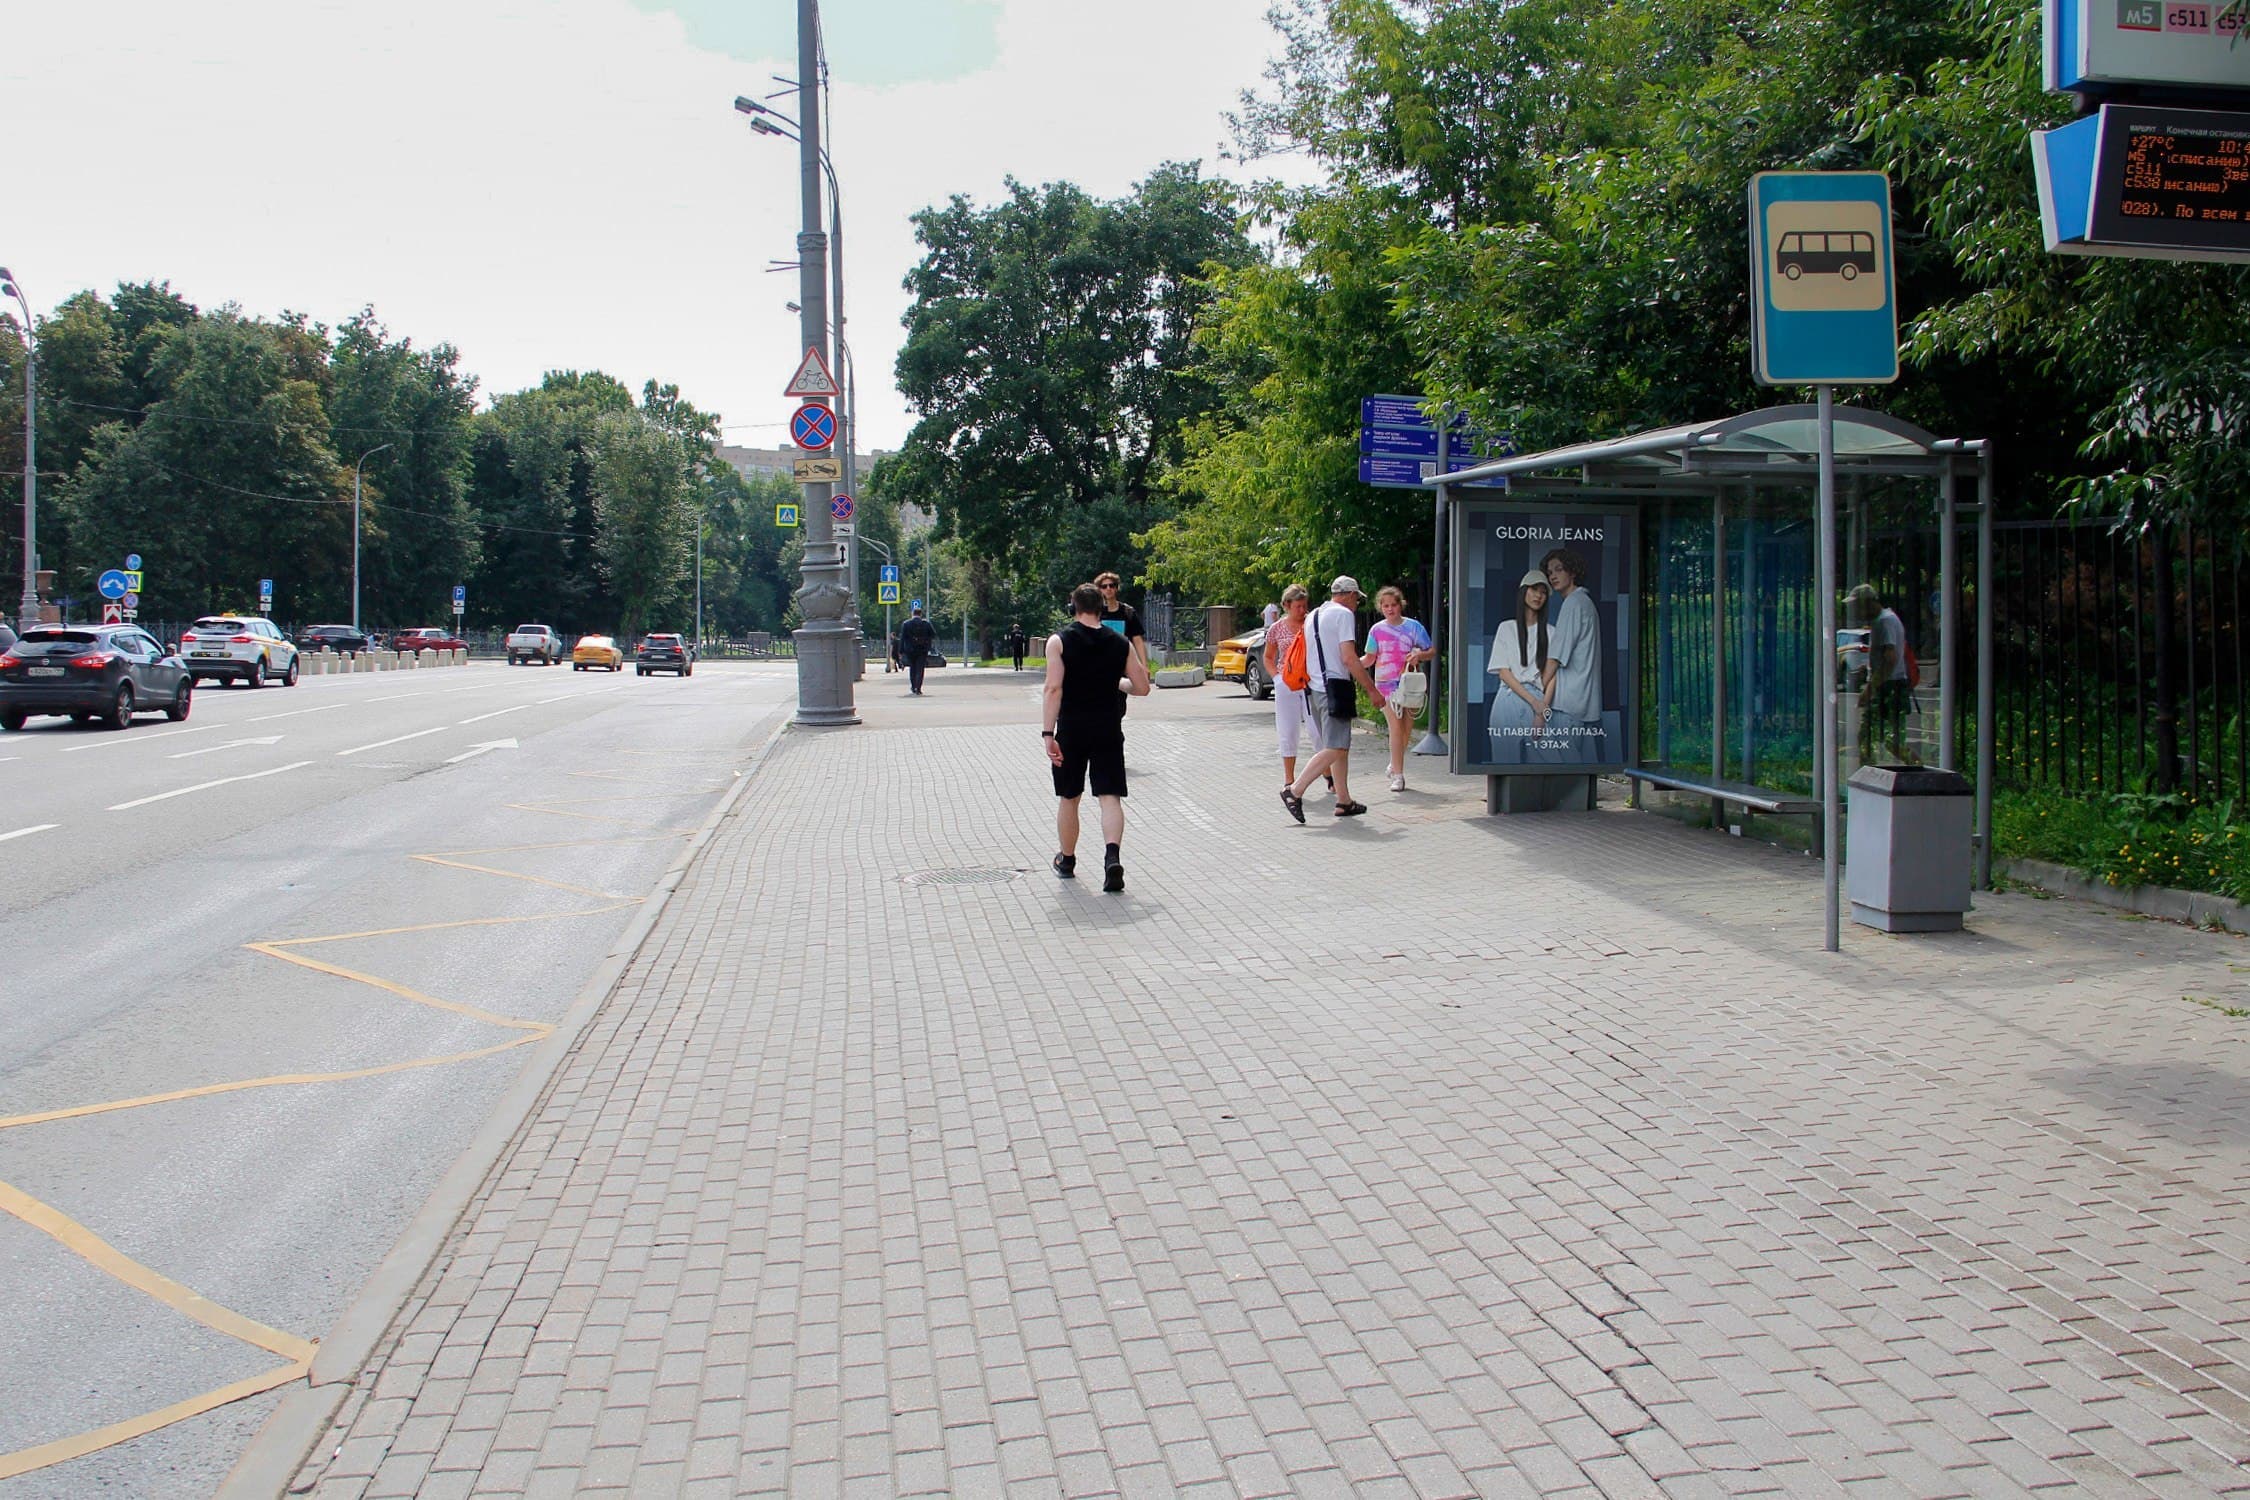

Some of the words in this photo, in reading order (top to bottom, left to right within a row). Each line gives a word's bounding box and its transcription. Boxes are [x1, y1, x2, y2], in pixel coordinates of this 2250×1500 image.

[2217, 14, 2246, 30] с53
[2166, 126, 2208, 137] Конечная
[2167, 154, 2249, 168] списанию)
[2175, 204, 2195, 218] По
[2202, 209, 2238, 220] всем
[1496, 526, 1553, 540] GLORIA
[1558, 527, 1604, 541] JEANS
[1487, 727, 1501, 737] ТЦ
[1503, 727, 1569, 738] ПАВЕЛЕЦКАЯ
[1571, 727, 1607, 738] ПЛАЗА,
[1540, 740, 1569, 750] ЭТАЖ
